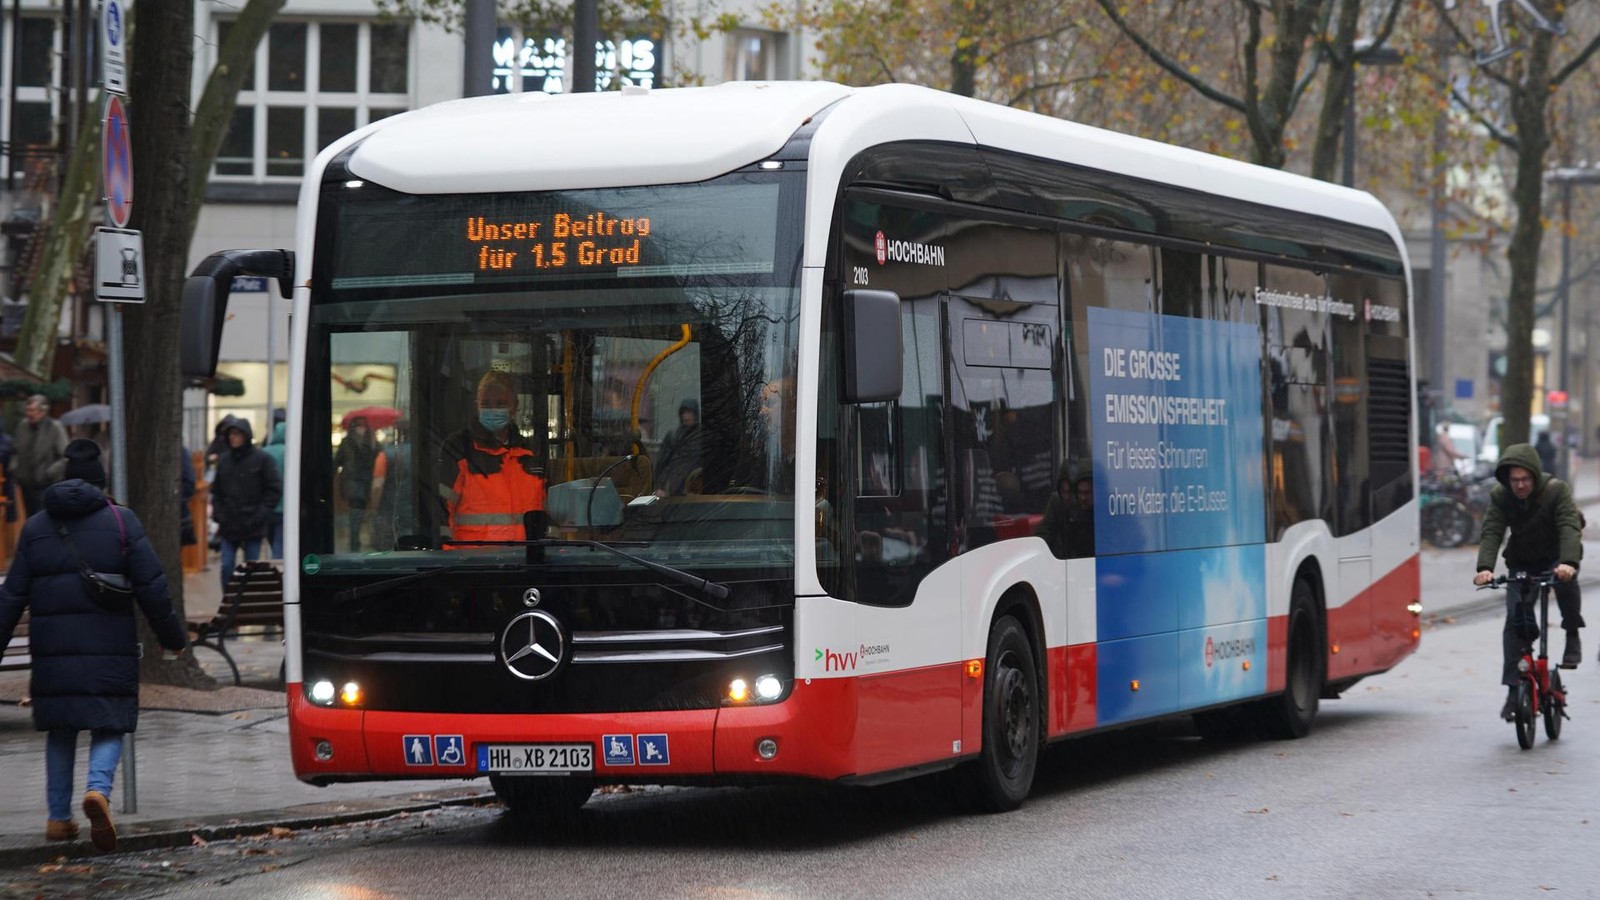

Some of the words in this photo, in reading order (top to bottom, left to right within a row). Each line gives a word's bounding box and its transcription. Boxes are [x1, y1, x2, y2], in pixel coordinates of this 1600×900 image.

[467, 216, 541, 241] Unser
[553, 212, 650, 237] Beitrag
[479, 245, 518, 270] für
[578, 240, 640, 266] Grad
[887, 239, 945, 266] HOCHBAHN
[853, 266, 869, 286] 2103
[1104, 348, 1126, 378] DIE
[1129, 350, 1181, 381] GROSSE
[1105, 394, 1228, 425] EMISSIONSFREIHEIT.
[1107, 441, 1125, 469] Für
[1127, 441, 1156, 469] leises
[1158, 441, 1209, 469] Schnurren
[1108, 487, 1136, 516] ohne
[1170, 486, 1185, 513] die
[825, 649, 858, 671] hvv
[1215, 638, 1256, 660] HOCHBAHN
[490, 749, 511, 768] HH
[524, 749, 544, 768] XB
[549, 748, 591, 768] 2103
